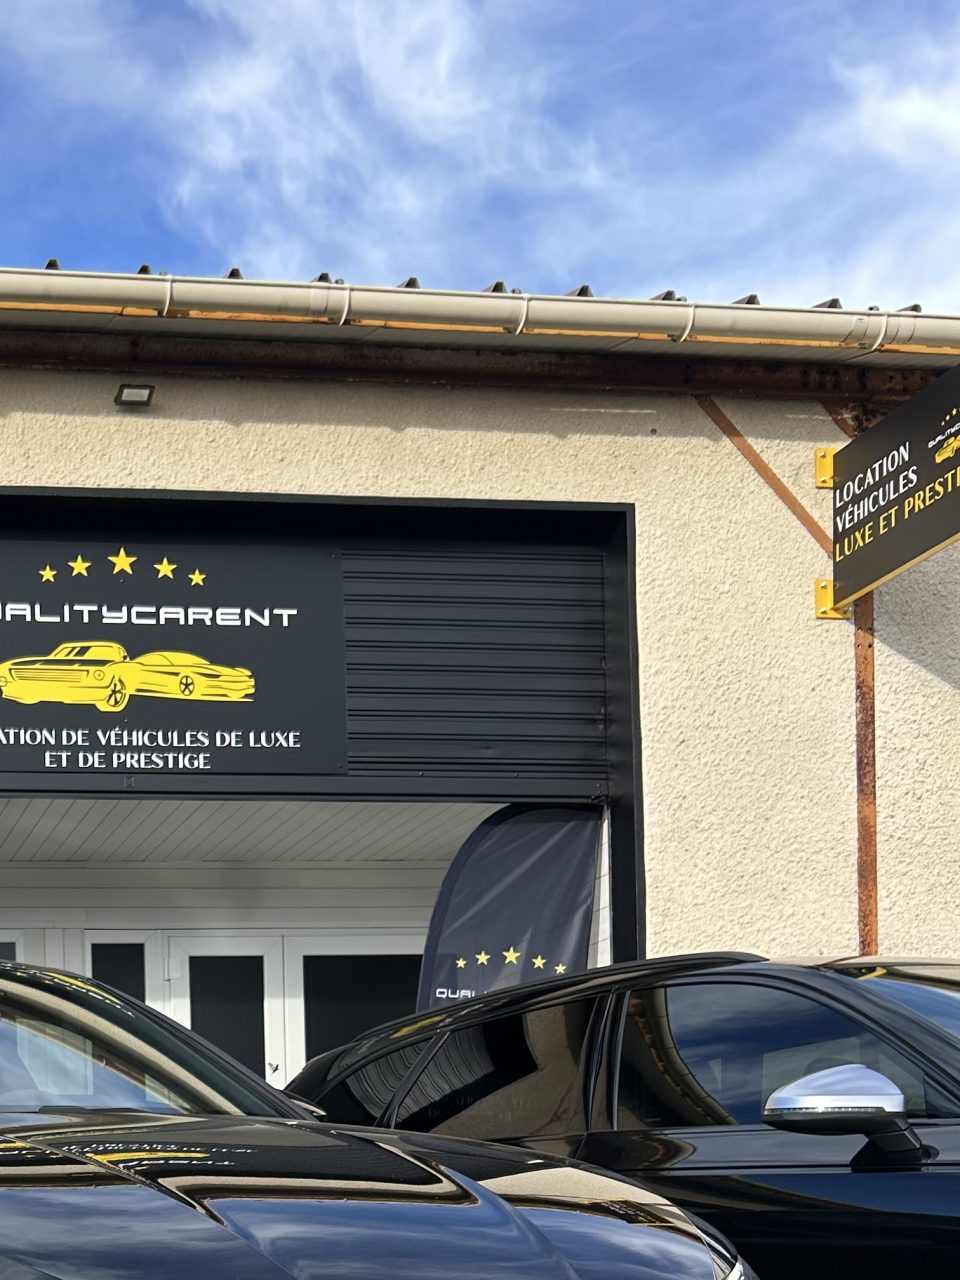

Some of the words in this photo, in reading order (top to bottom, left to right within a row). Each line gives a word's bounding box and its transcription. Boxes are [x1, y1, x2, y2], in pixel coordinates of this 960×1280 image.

[835, 441, 910, 508] LOCATION
[836, 466, 918, 533] VÉHICULES
[835, 521, 874, 562] LUXE
[879, 506, 899, 535] ET
[44, 751, 72, 768] ET
[78, 751, 106, 768] DE
[112, 752, 211, 769] PRESTIGE
[62, 728, 90, 746] DE
[96, 726, 210, 748] VÉHICULES
[216, 731, 243, 748] DE
[249, 731, 301, 748] LUXE
